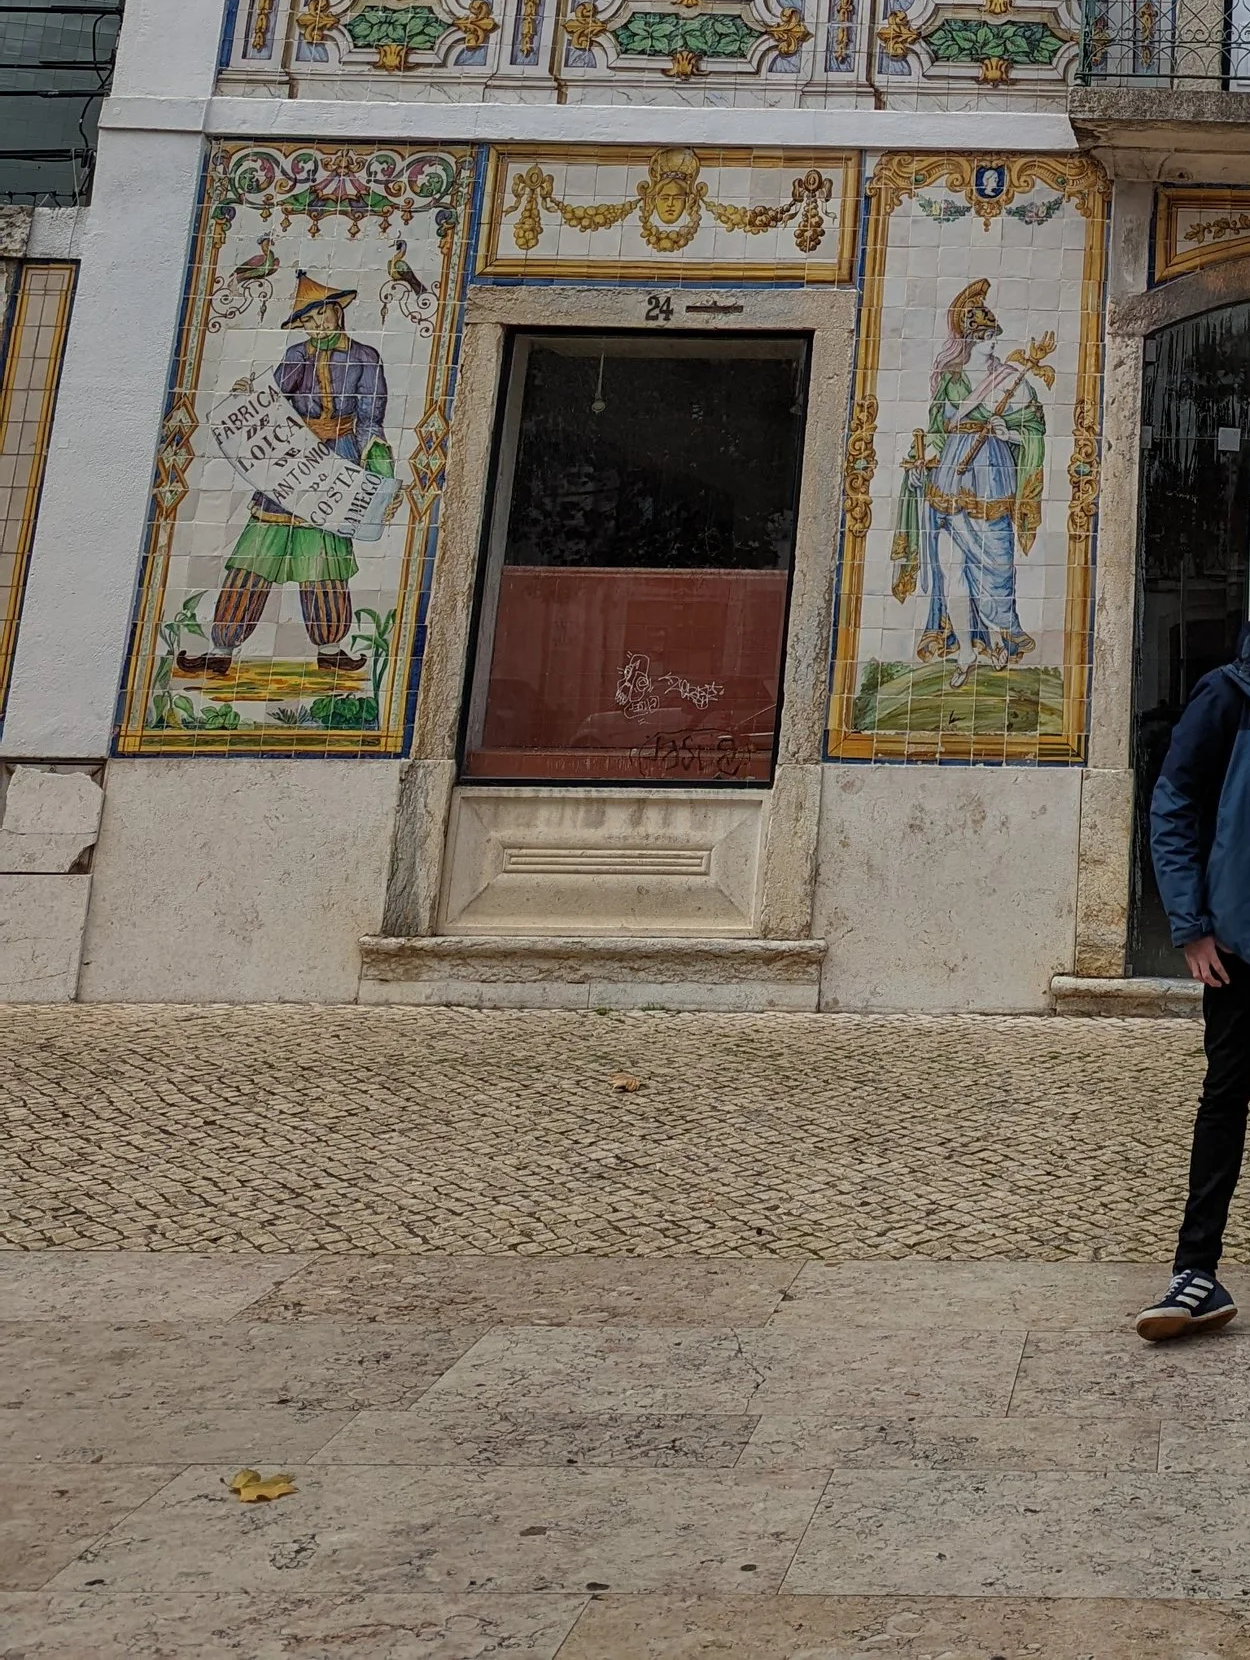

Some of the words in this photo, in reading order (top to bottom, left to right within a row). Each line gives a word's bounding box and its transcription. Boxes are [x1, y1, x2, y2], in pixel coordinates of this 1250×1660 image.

[645, 294, 674, 321] 24
[211, 385, 281, 445] FABRICA
[237, 415, 304, 473] LOIÇA
[246, 414, 270, 441] DE
[272, 447, 302, 468] DE
[272, 441, 331, 504] ANTONIO
[310, 465, 361, 527] COSTA
